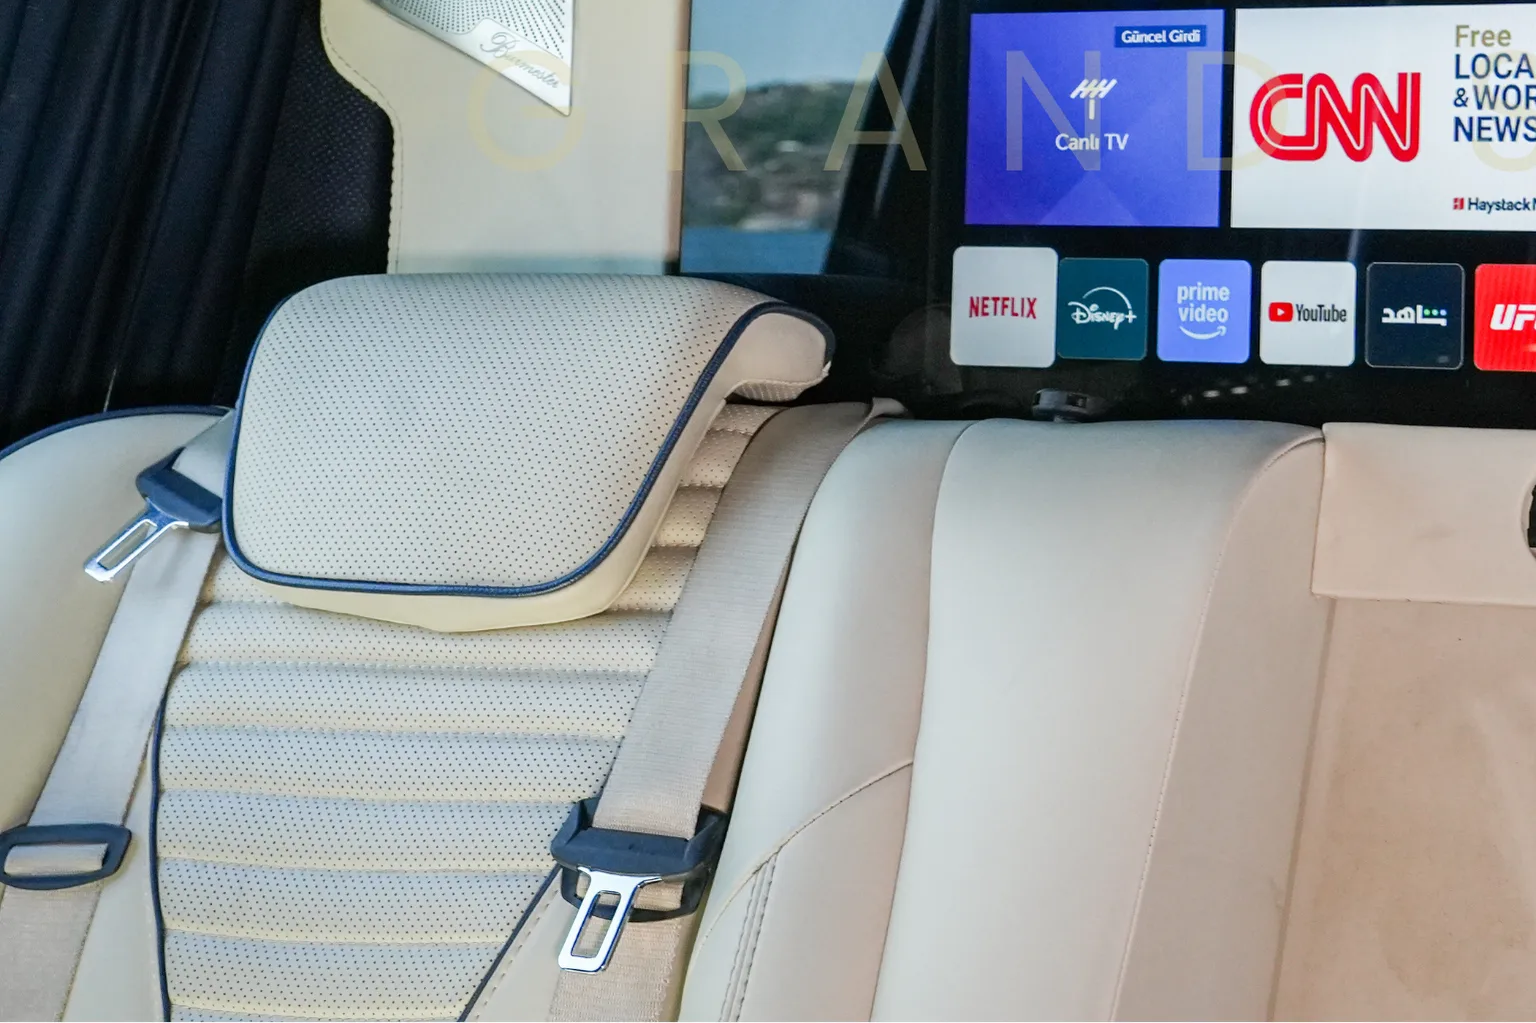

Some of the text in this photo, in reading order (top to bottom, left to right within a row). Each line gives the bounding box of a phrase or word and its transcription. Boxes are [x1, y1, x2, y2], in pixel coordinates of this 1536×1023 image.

[1121, 29, 1202, 45] Güncel Girdi
[1455, 24, 1512, 47] Free
[1249, 71, 1422, 163] CNN
[1055, 133, 1130, 151] Canlı TV
[1177, 282, 1230, 305] prime
[969, 296, 1039, 319] NETFLIX
[1178, 303, 1229, 323] video
[1296, 303, 1347, 323] YouTube
